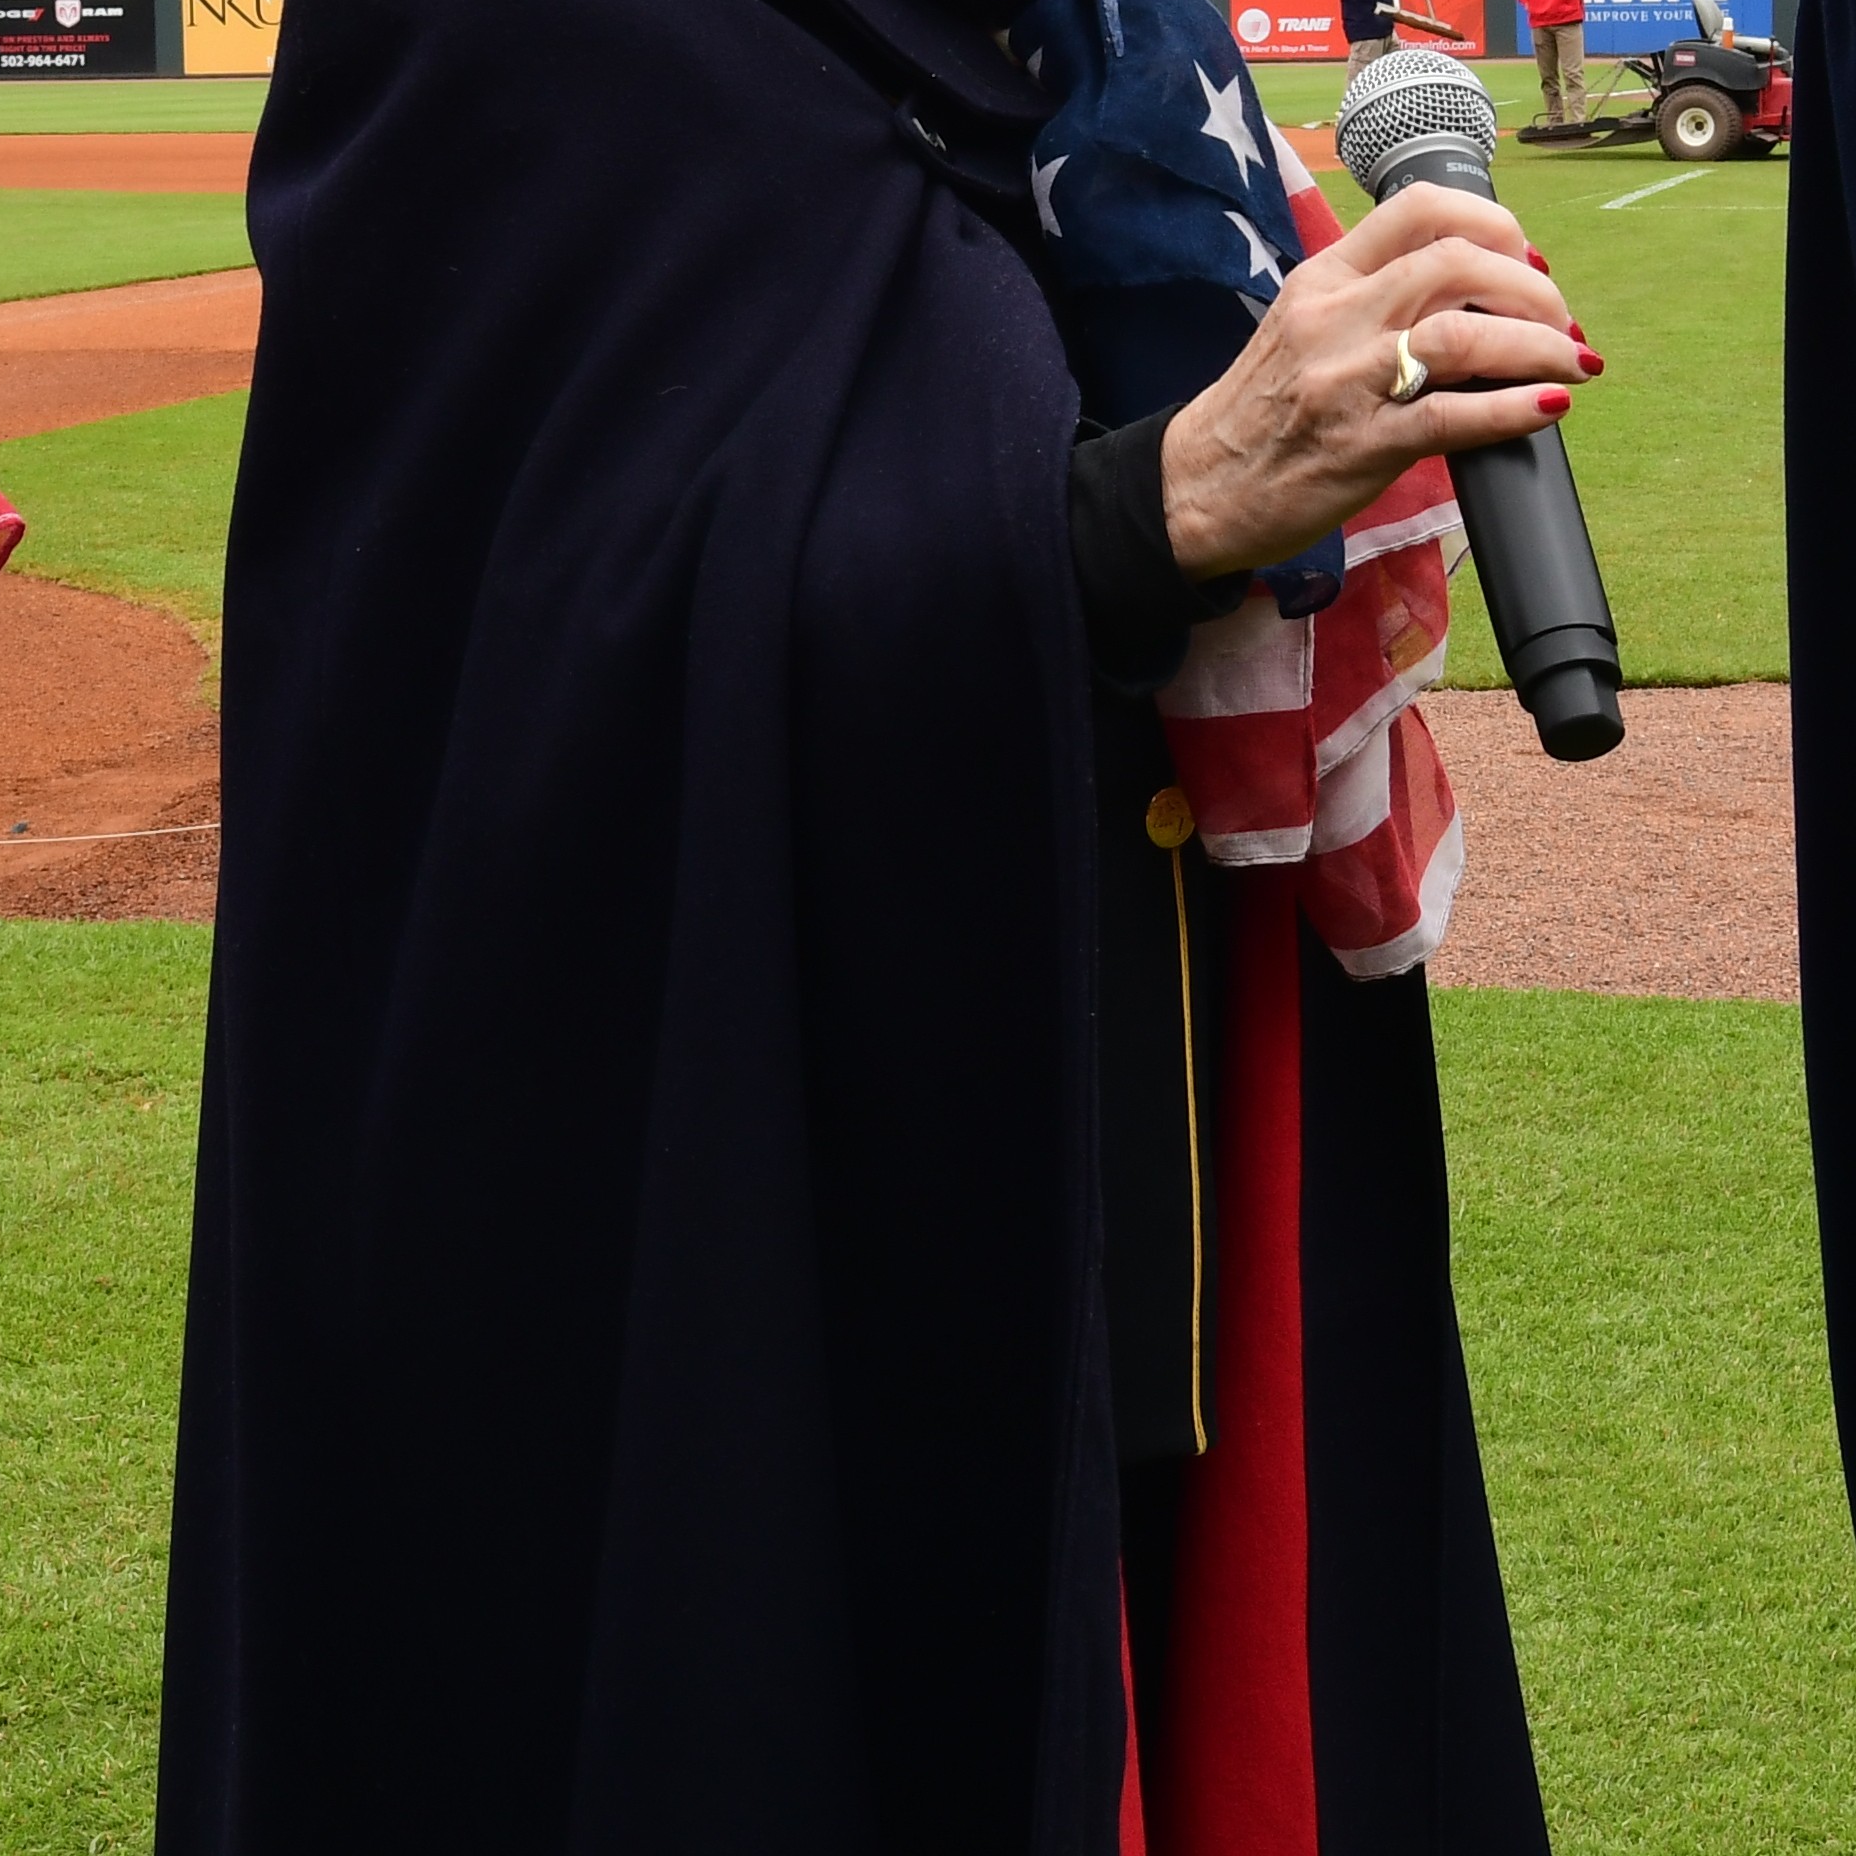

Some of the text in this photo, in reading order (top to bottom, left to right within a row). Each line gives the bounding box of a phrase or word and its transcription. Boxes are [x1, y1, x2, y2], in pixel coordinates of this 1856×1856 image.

[82, 7, 124, 17] RAM
[1584, 10, 1693, 22] IMPROVE YOUR
[1277, 17, 1332, 32] TRANE
[0, 54, 85, 67] 502-964-6471
